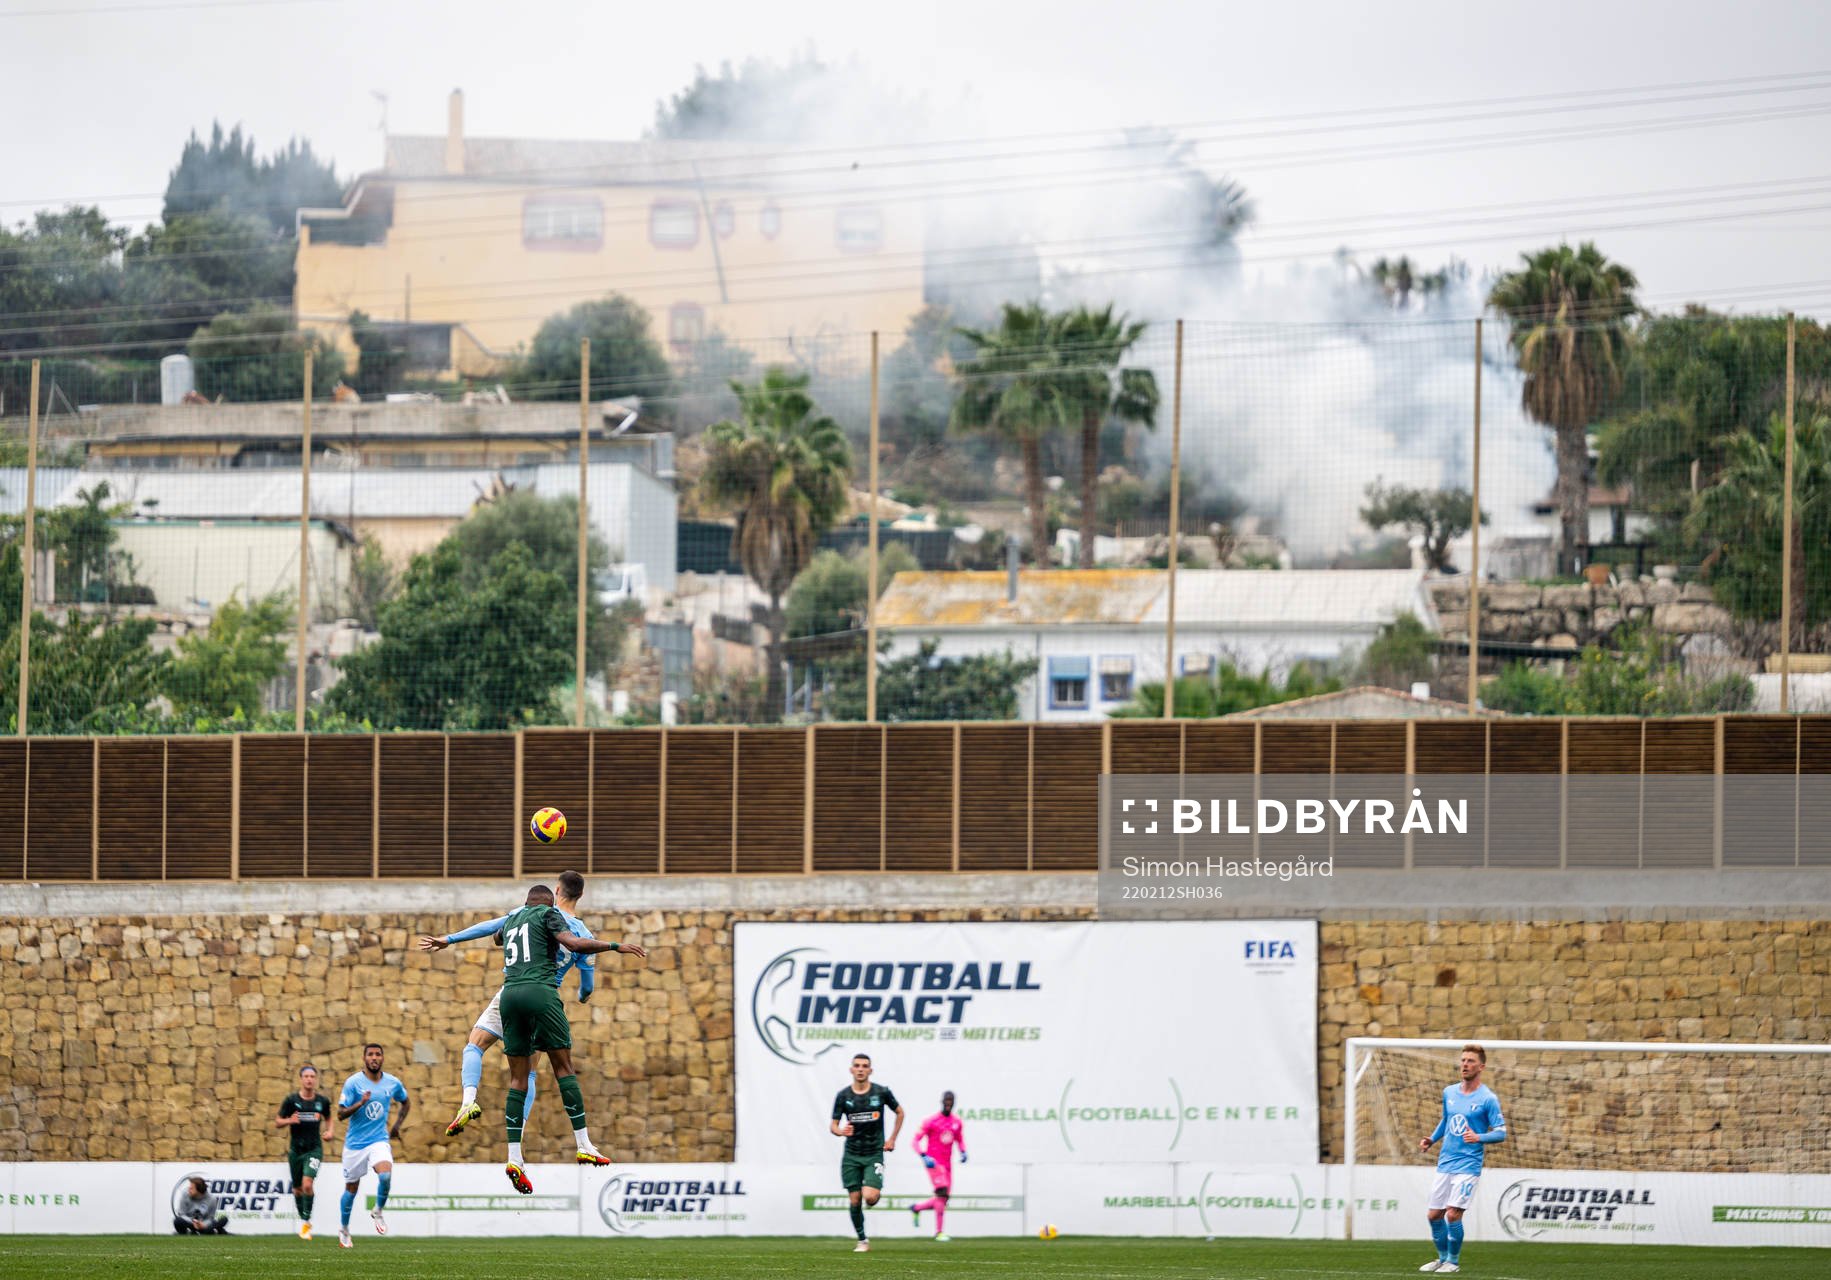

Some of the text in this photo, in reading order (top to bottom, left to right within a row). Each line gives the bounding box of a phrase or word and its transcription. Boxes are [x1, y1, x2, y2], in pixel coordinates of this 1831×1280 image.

[505, 922, 531, 967] 31
[1245, 940, 1295, 959] FIFA
[802, 961, 1041, 991] FOOTBALL
[795, 995, 973, 1024] IMPACT
[796, 1027, 873, 1041] TRAINING
[876, 1027, 934, 1041] CAMPS
[962, 1027, 1042, 1041] MATCHES
[1067, 1106, 1176, 1121] FOOTBALL
[1183, 1106, 1300, 1121] CENTER
[625, 1180, 746, 1196] FOOTBALL
[1525, 1187, 1656, 1205] FOOTBALL
[621, 1197, 711, 1212] IMPACT
[1103, 1196, 1200, 1209] MARBELLA
[1206, 1195, 1297, 1209] FOOTBALL
[1522, 1204, 1618, 1221] IMPACT
